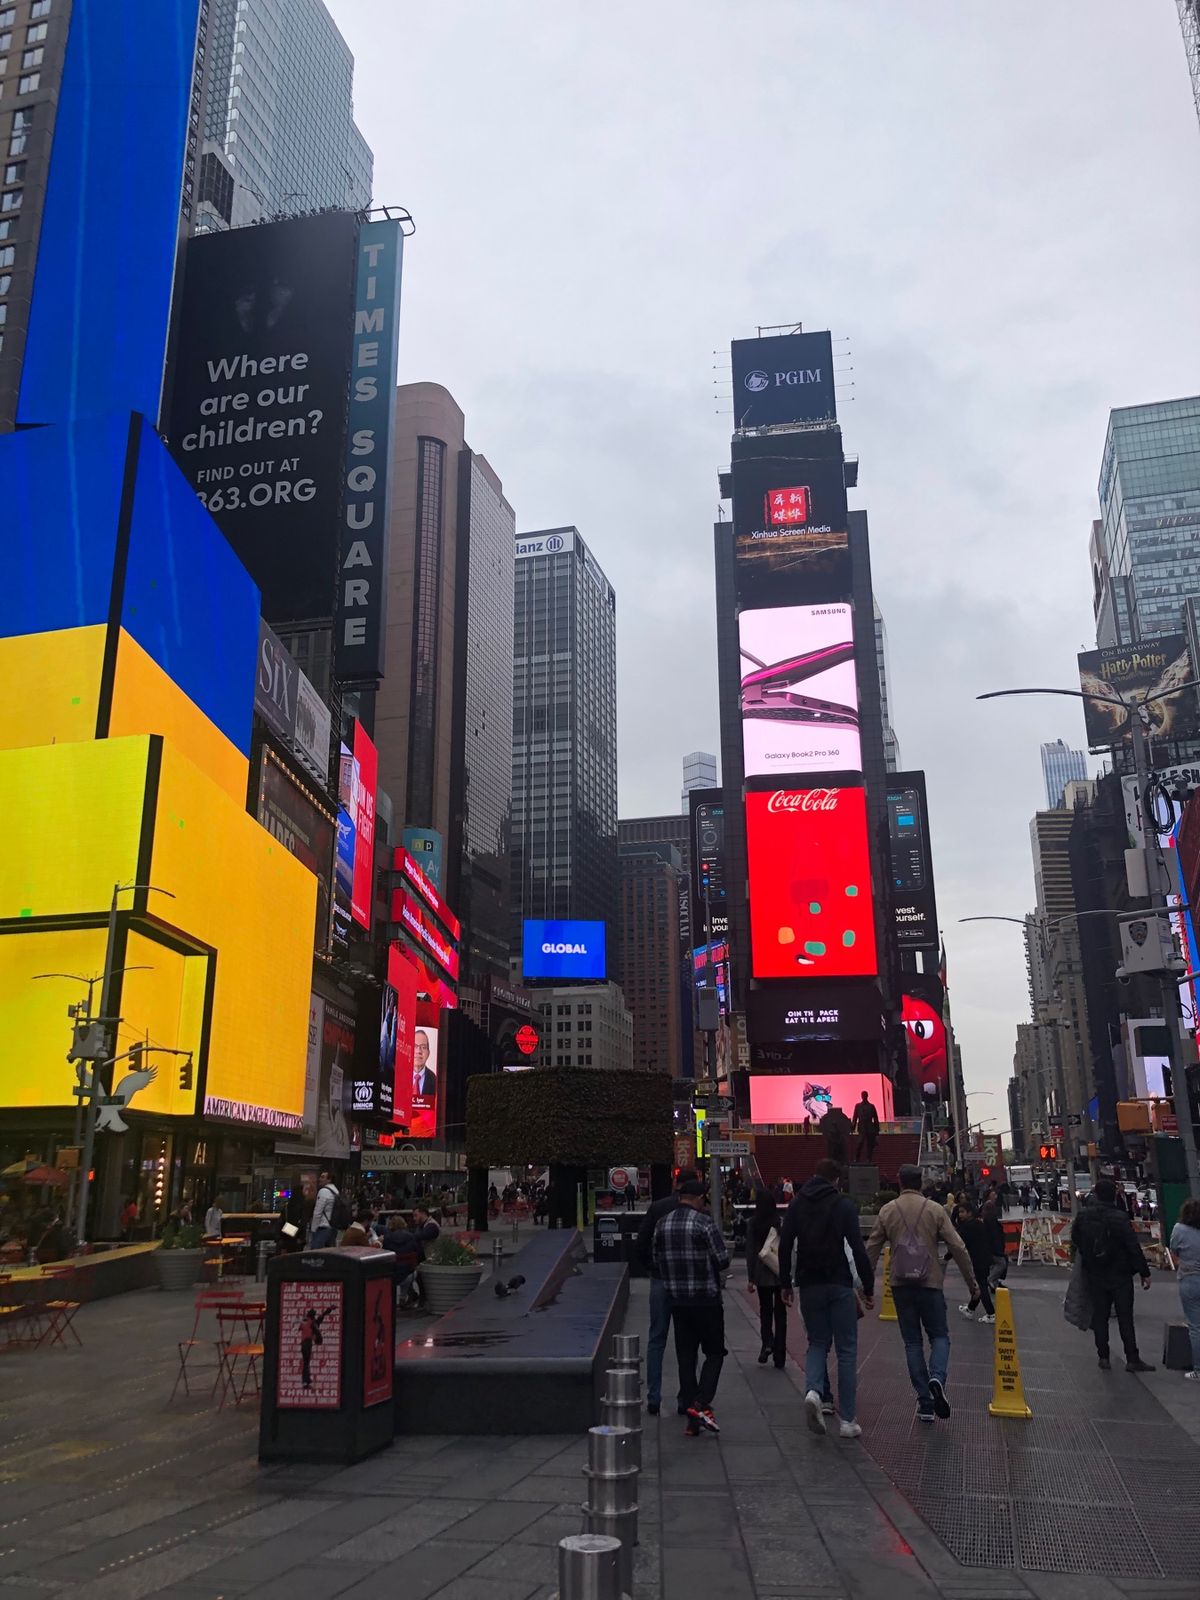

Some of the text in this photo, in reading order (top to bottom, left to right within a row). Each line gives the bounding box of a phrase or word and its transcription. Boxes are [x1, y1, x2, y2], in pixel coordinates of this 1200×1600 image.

[207, 352, 309, 383] Where
[774, 368, 822, 387] PGIM
[200, 384, 310, 416] are our
[182, 409, 324, 451] children?
[343, 243, 385, 646] TIMES SQUARE
[197, 457, 300, 484] FIND OUT AT
[751, 523, 831, 540] Xinhua Screen Media
[811, 607, 846, 616] SAMSUNG
[1116, 641, 1160, 655] BROADWAY
[1100, 658, 1132, 680] Harry
[1132, 652, 1167, 670] Potter
[764, 748, 840, 760] Galaxy Book2 Pro 360
[767, 787, 841, 813] Coca-Cola
[541, 942, 587, 954] GLOBAL
[819, 1009, 839, 1017] PACK
[203, 1096, 248, 1120] AMERICAN
[248, 1103, 269, 1125] EAGLE
[362, 1153, 431, 1167] SWAROVSKI
[280, 1388, 338, 1397] THRILLER
